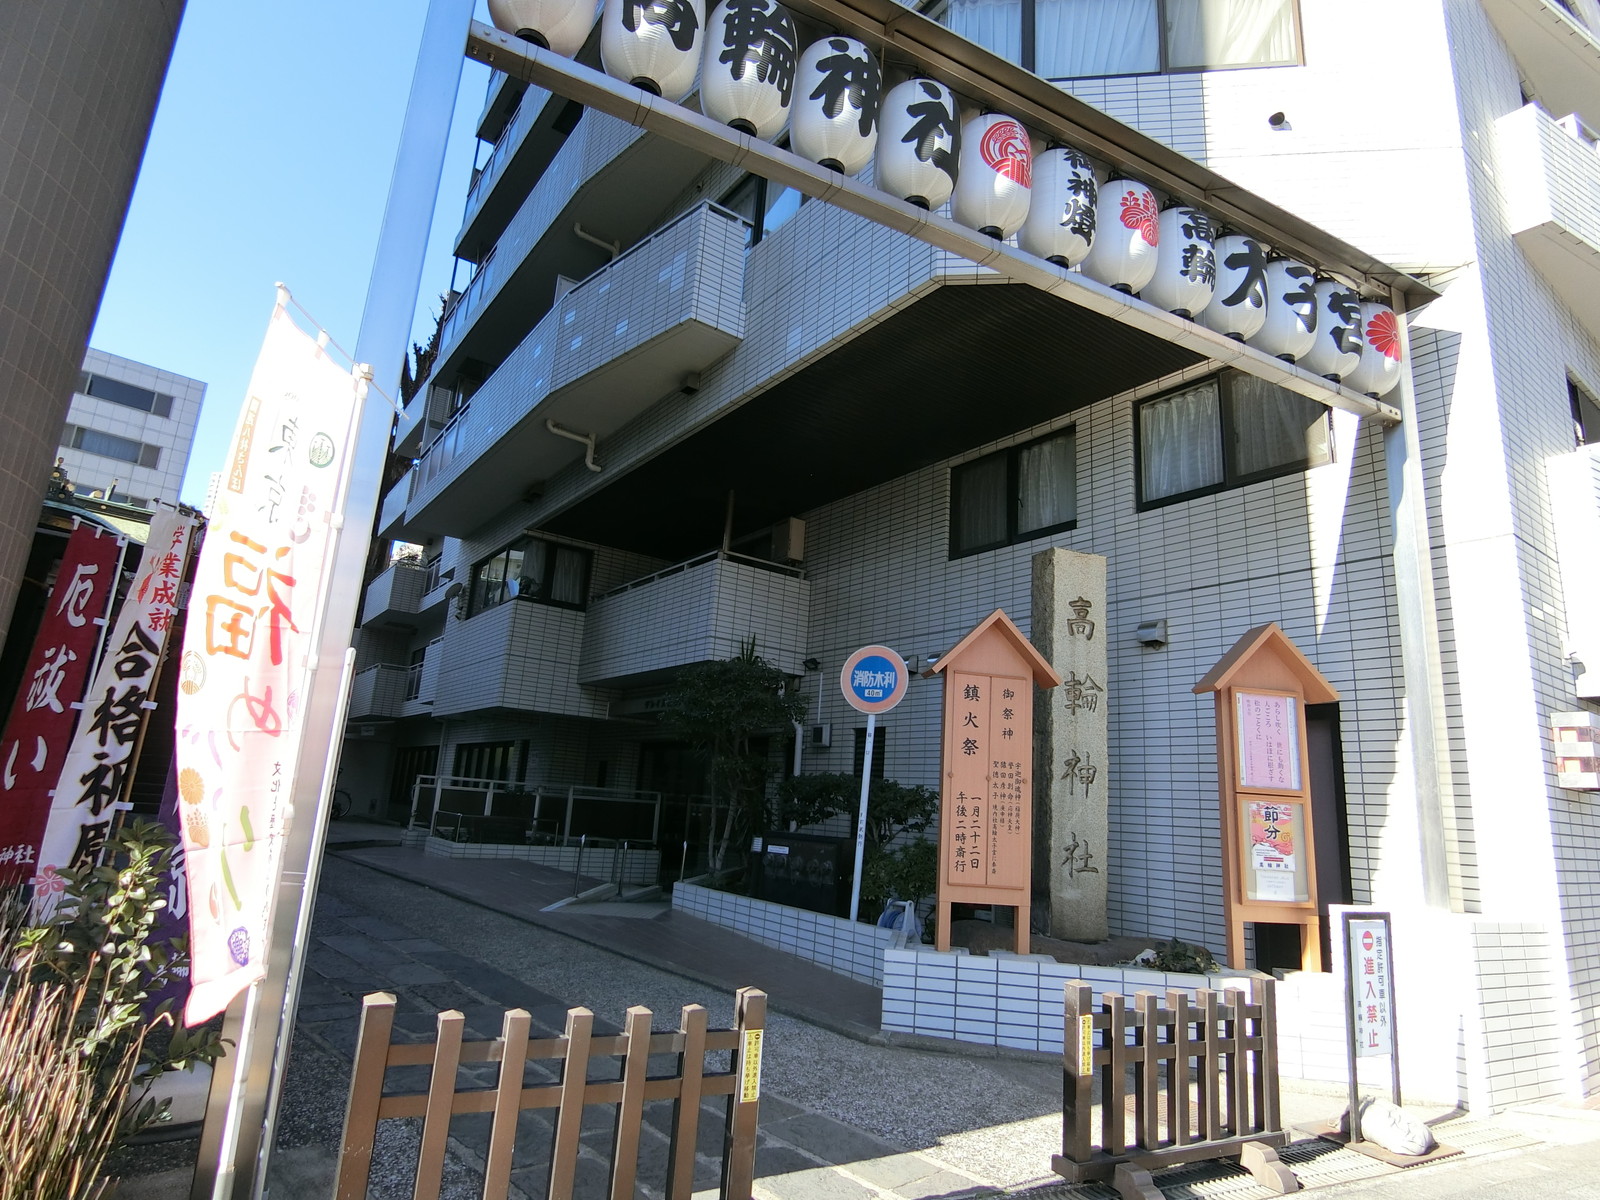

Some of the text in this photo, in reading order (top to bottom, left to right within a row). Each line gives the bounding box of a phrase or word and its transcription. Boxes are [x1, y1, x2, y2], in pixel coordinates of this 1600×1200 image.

[1178, 210, 1217, 293] 高輪
[147, 525, 186, 633] 学業成就
[4, 563, 99, 791] 厄祓い
[852, 669, 896, 689] 消防水利
[1001, 687, 1015, 741] 御祭神
[960, 683, 981, 756] 鎮火祭
[1059, 595, 1104, 879] 高輪神社
[969, 796, 982, 870] 一月二十二日
[1263, 805, 1281, 840] 節分
[1364, 956, 1380, 1049] 進入禁止
